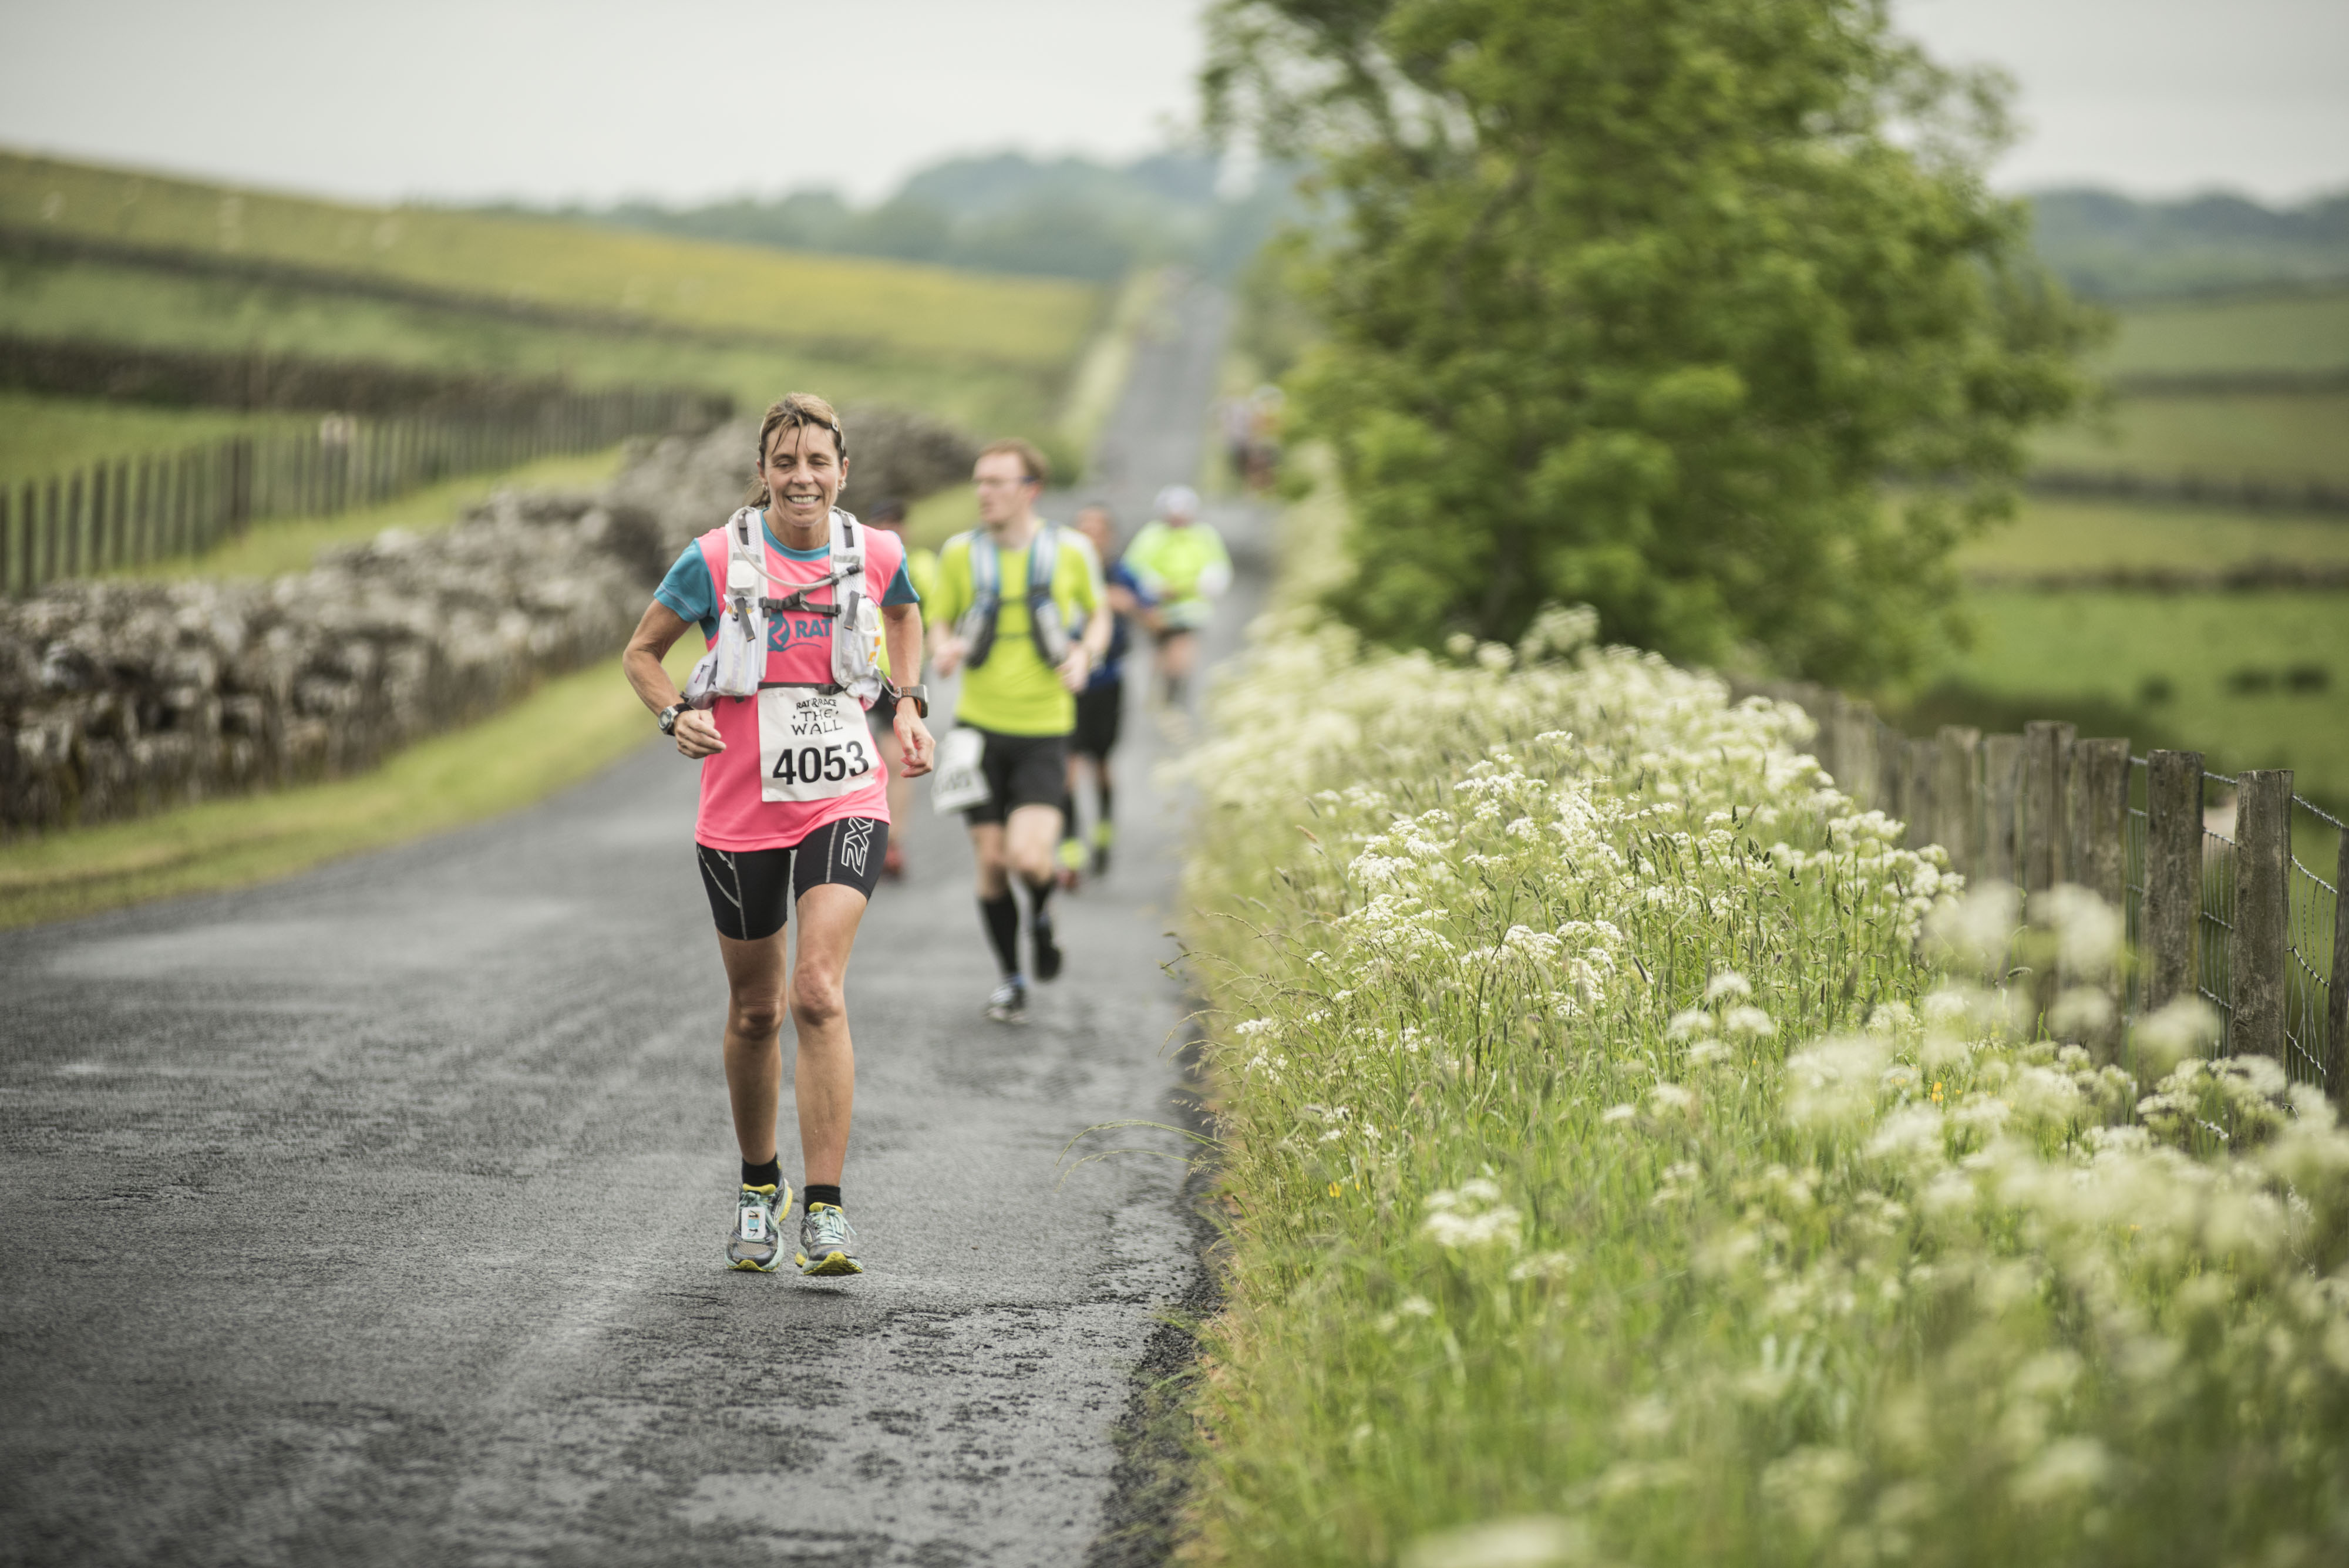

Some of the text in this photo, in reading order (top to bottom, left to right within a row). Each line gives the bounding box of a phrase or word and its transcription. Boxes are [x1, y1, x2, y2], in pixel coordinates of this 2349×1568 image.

[795, 618, 832, 638] RAT
[796, 699, 810, 709] RAT
[819, 698, 836, 706] RACE
[799, 709, 833, 721] THE
[790, 719, 843, 735] WALL
[772, 740, 869, 785] 4053
